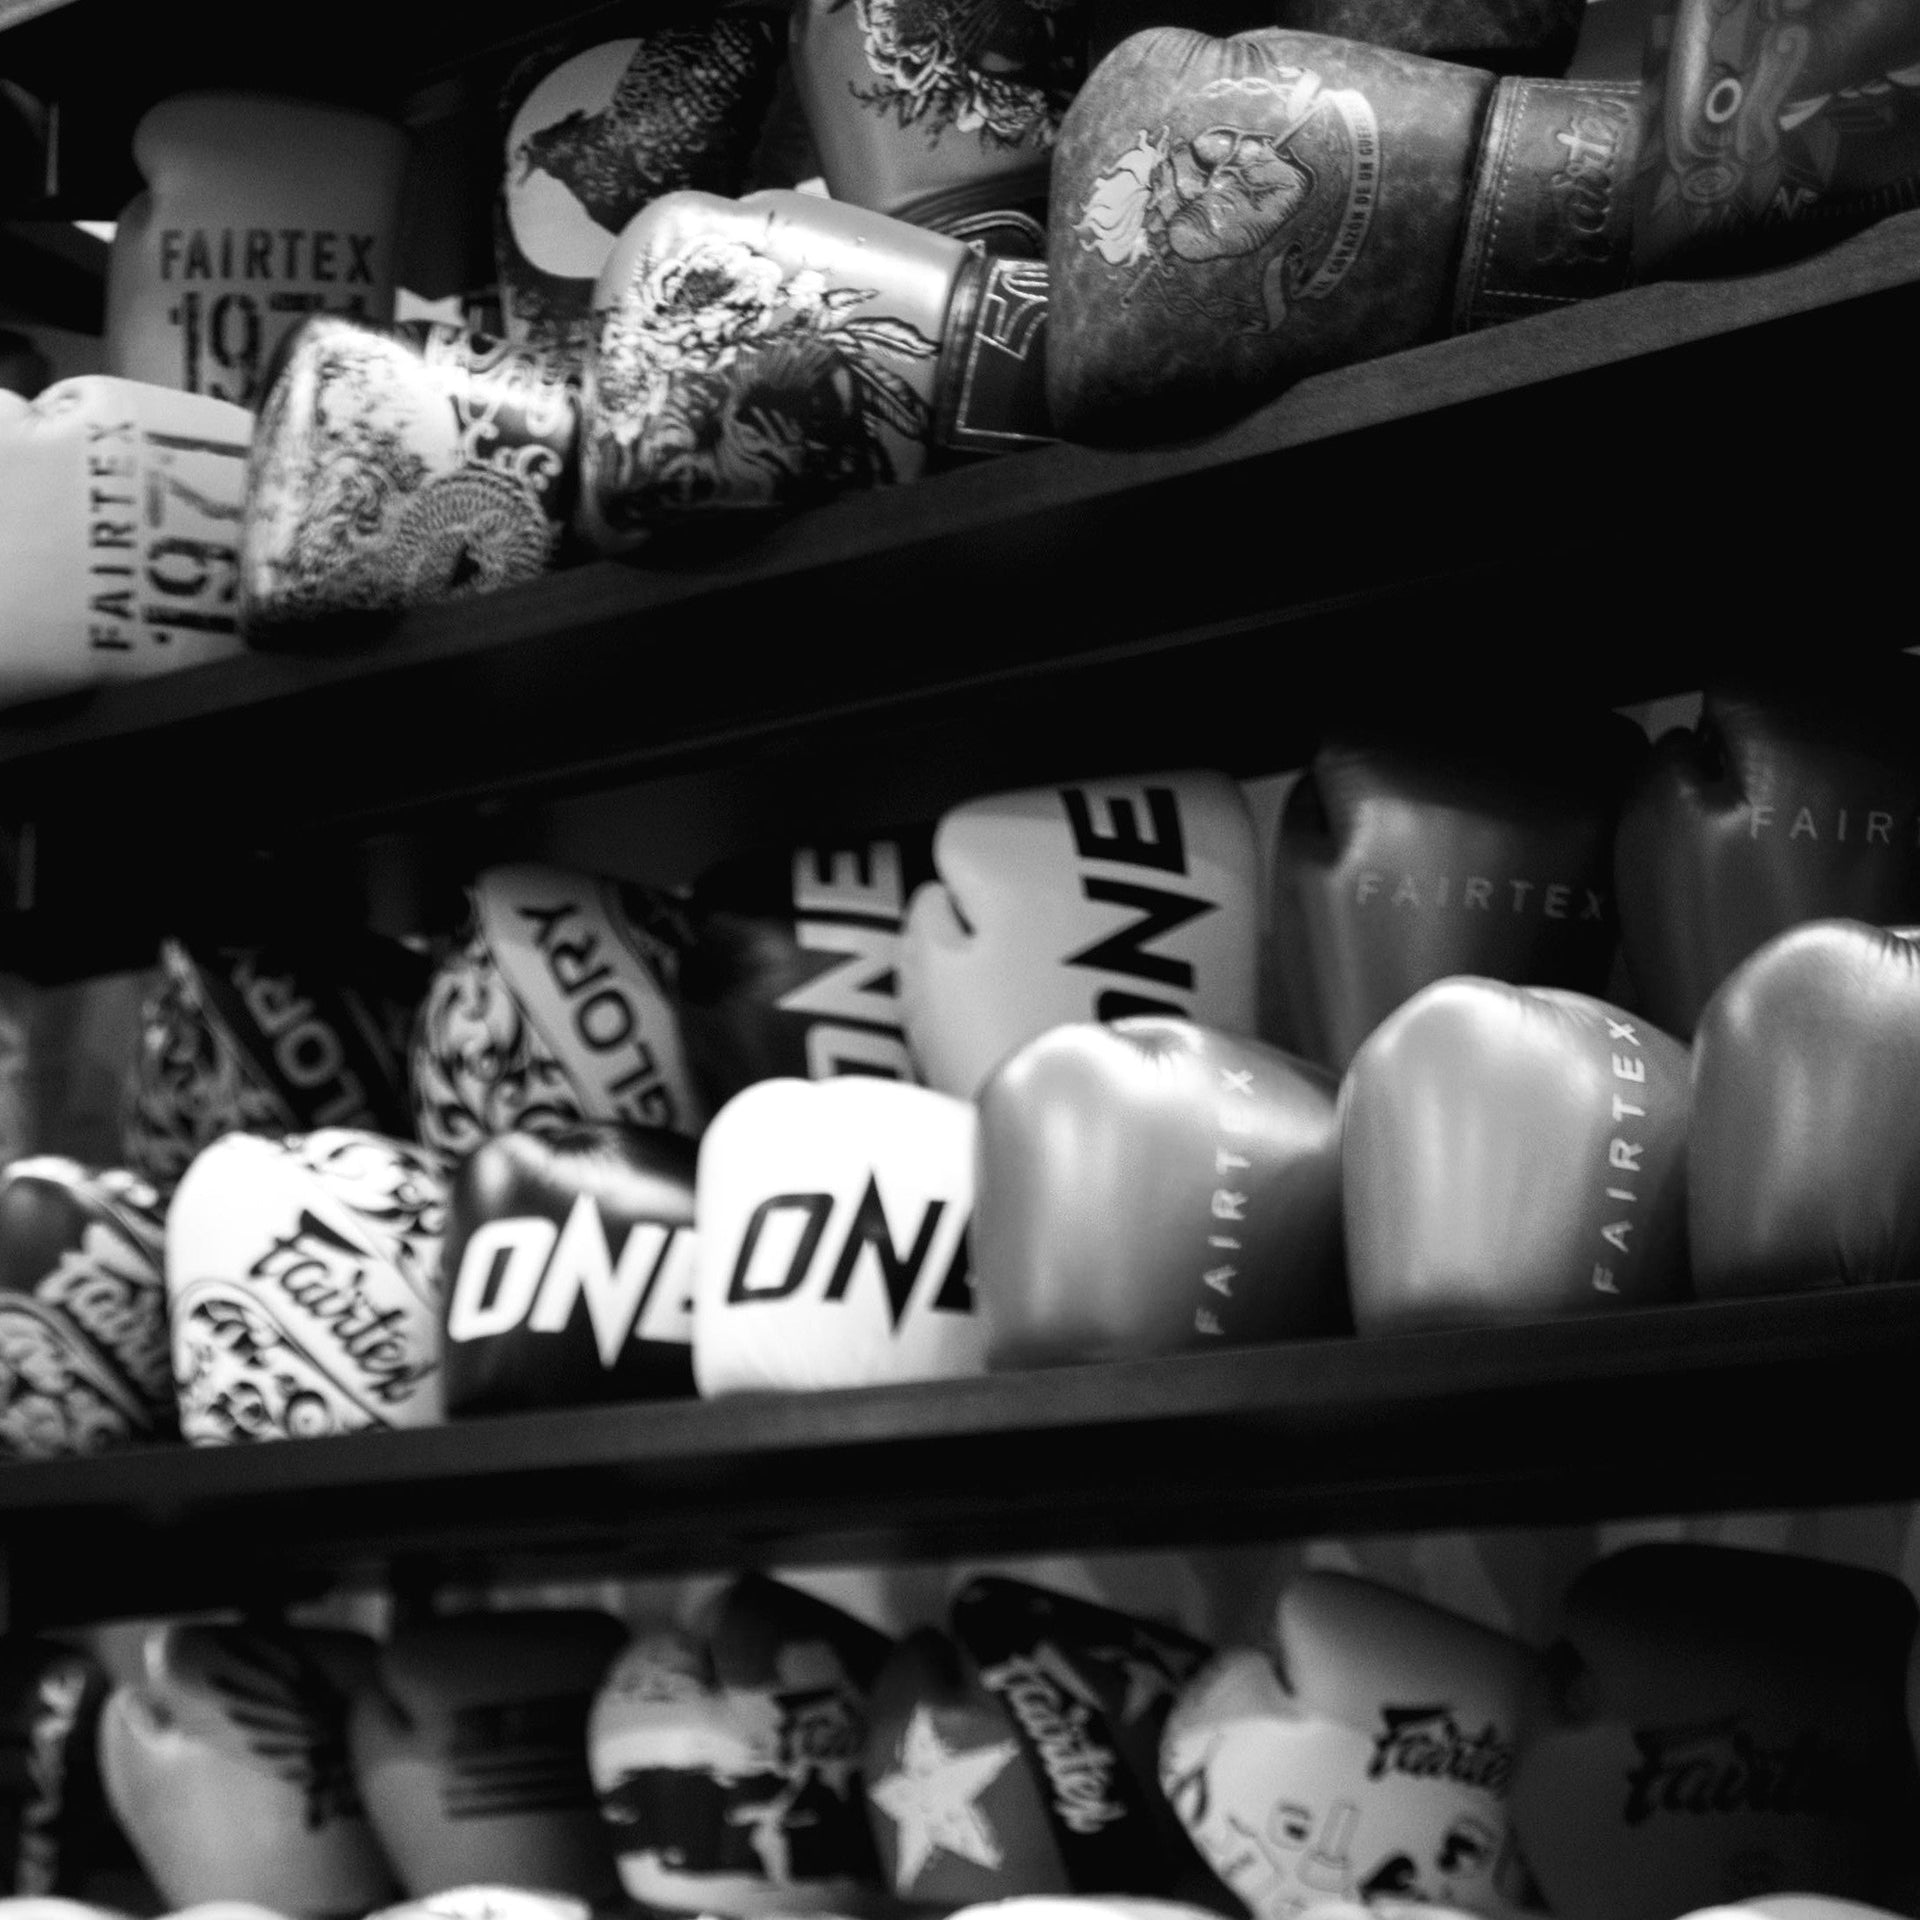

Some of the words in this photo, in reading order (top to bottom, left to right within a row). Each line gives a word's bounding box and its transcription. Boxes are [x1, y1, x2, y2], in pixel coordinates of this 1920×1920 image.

[159, 228, 376, 284] FAIRTEX
[168, 291, 368, 420] 197
[86, 422, 136, 652] FAIRTEX
[1749, 803, 1920, 847] FAIR
[1056, 784, 1223, 1020] NE
[1356, 870, 1605, 922] FAIRTEX
[1592, 1016, 1647, 1296] FAIRTEX
